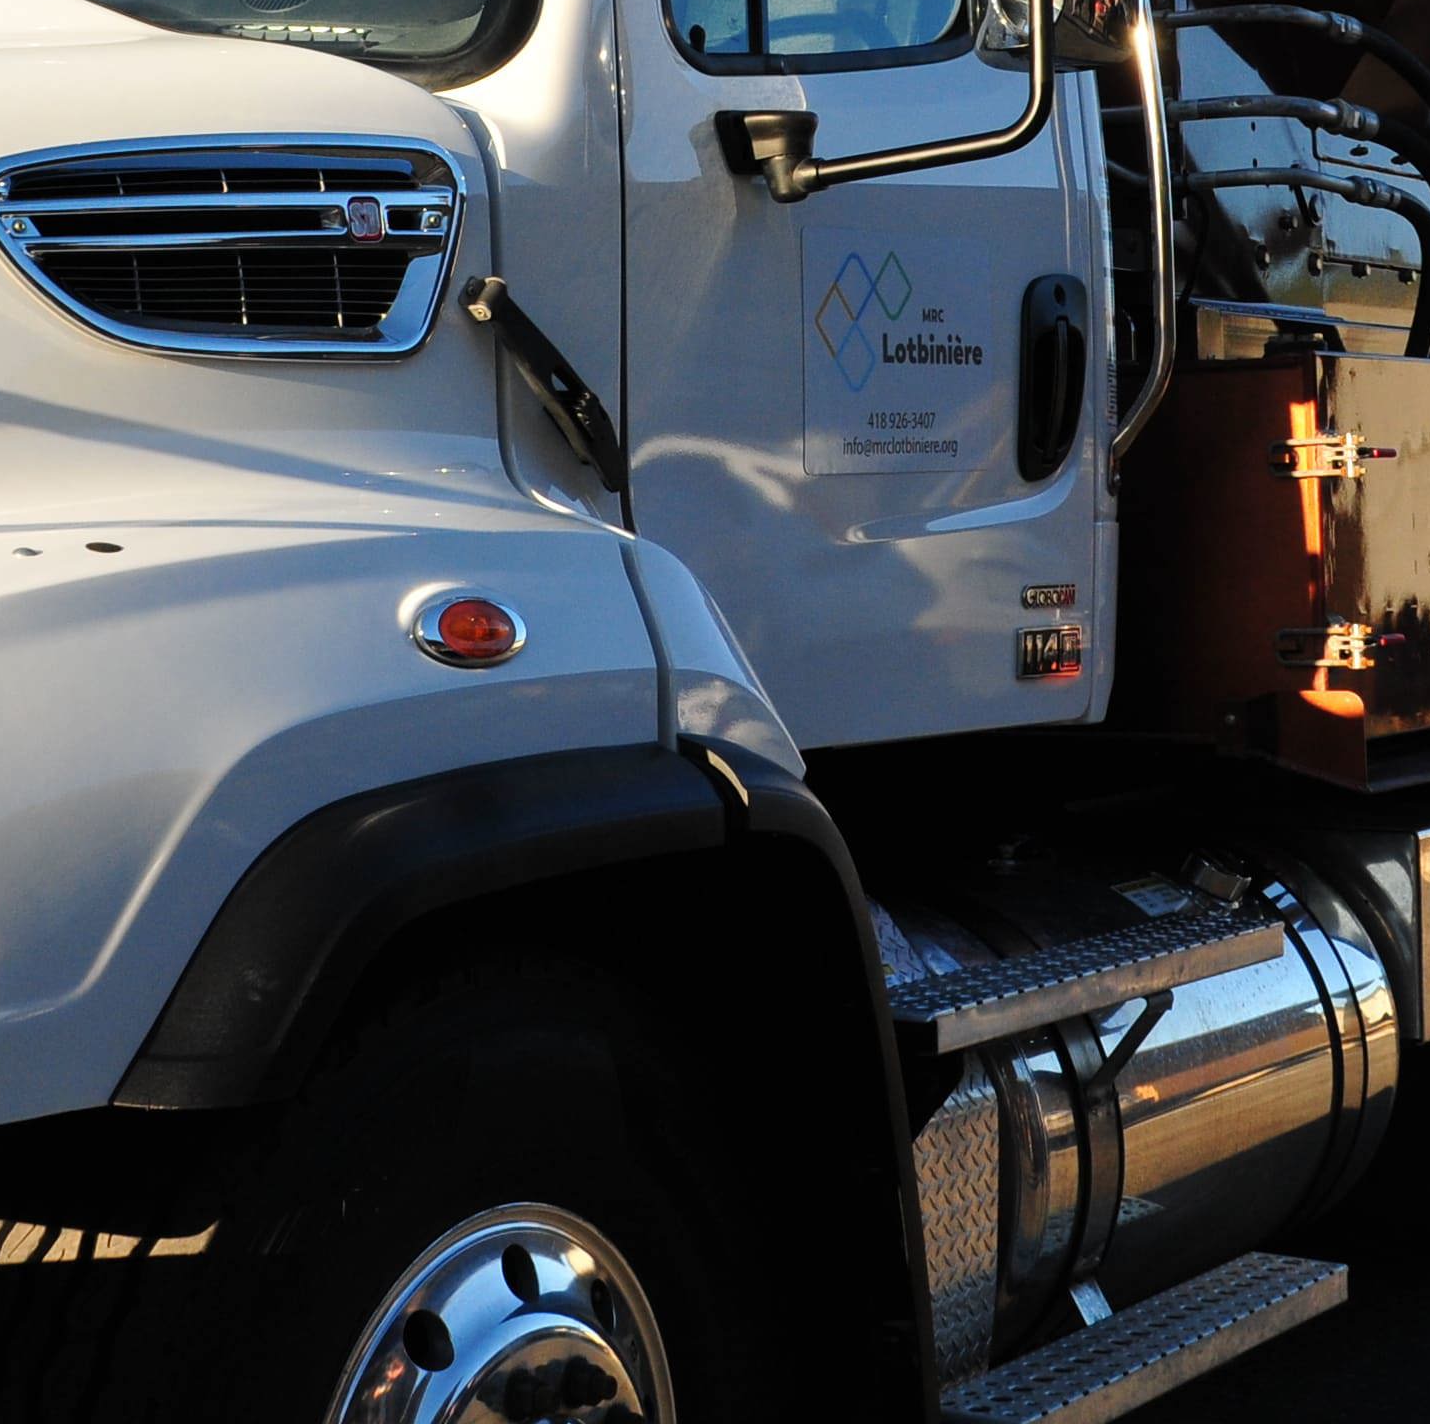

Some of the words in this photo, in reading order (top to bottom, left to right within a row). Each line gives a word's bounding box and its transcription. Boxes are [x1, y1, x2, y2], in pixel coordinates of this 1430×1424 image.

[349, 202, 380, 237] SD
[922, 308, 944, 323] MRC
[882, 333, 983, 366] Lotbinière
[867, 412, 887, 430] 418
[889, 412, 936, 430] 926-3407
[842, 435, 959, 458] info@mrclotbiniere.org
